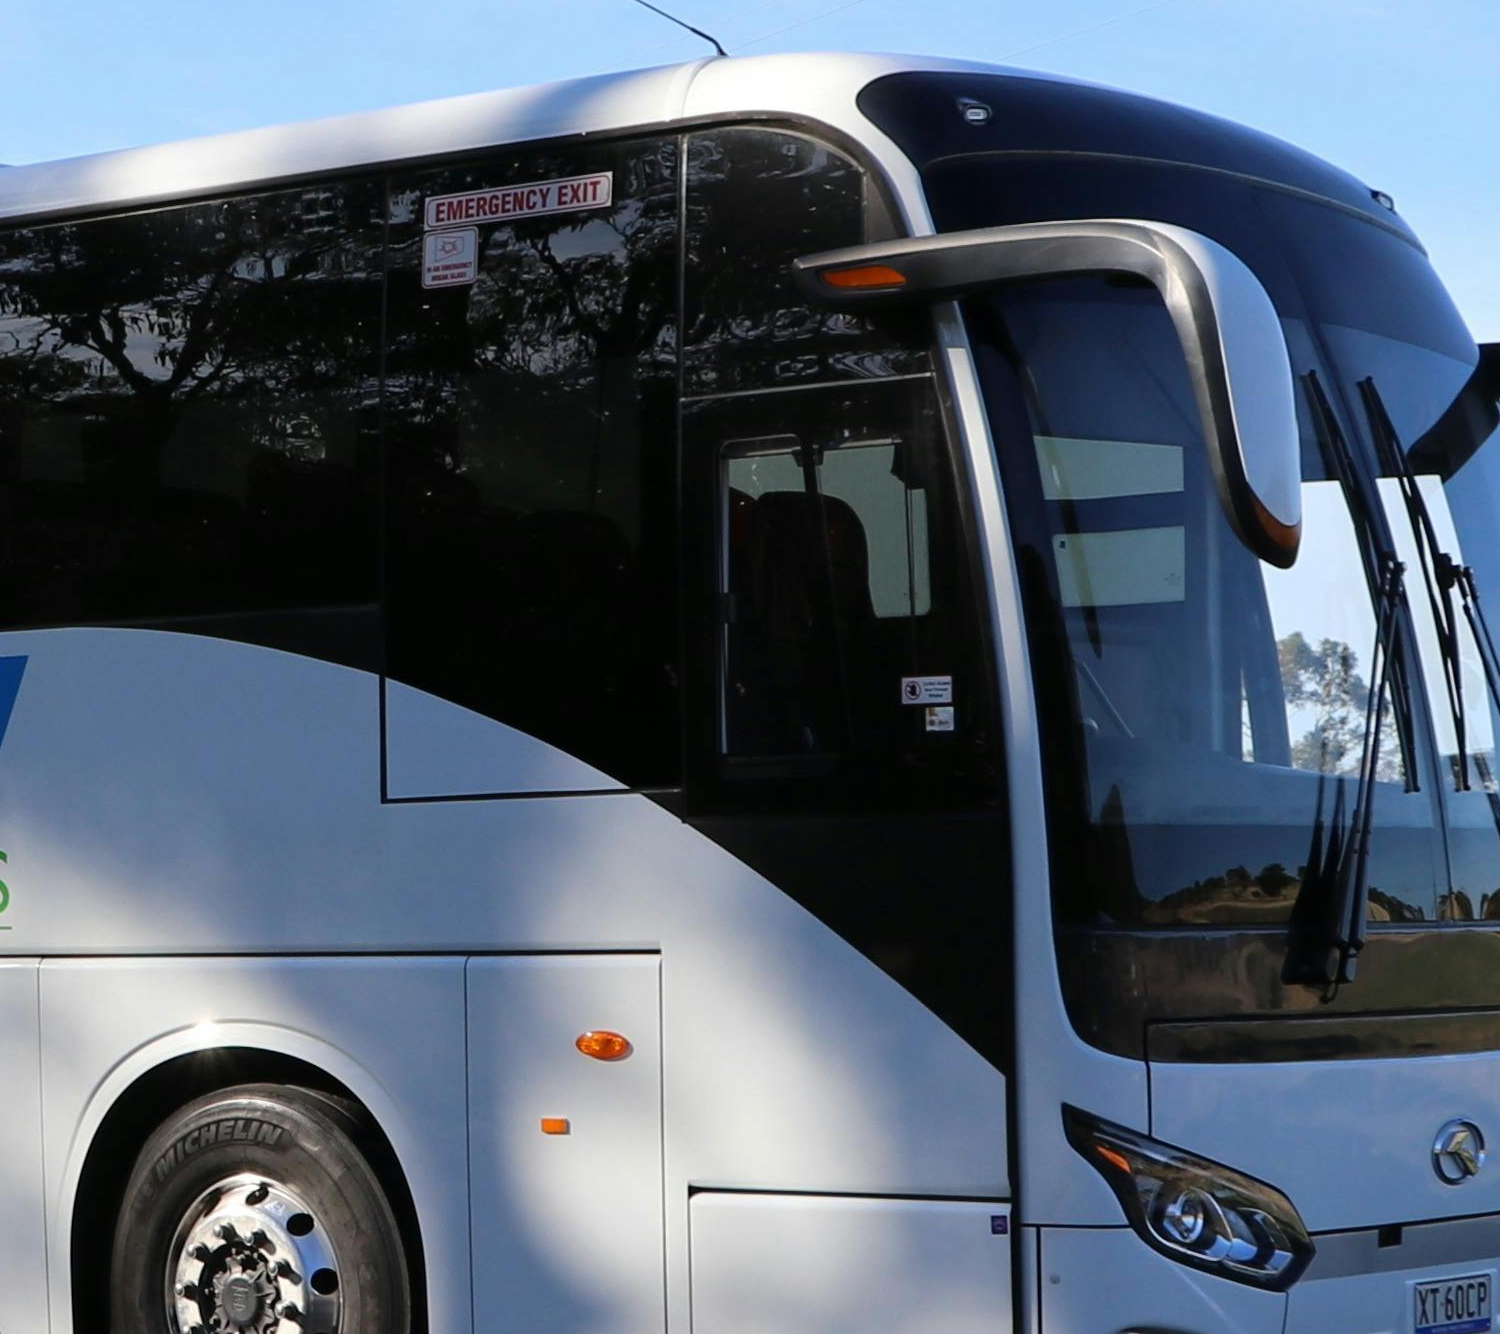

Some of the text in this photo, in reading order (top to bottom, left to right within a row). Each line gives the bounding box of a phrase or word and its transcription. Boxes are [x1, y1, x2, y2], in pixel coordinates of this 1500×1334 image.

[435, 180, 601, 223] EMERGENCY EXIT
[155, 1119, 283, 1182] MICHELIN
